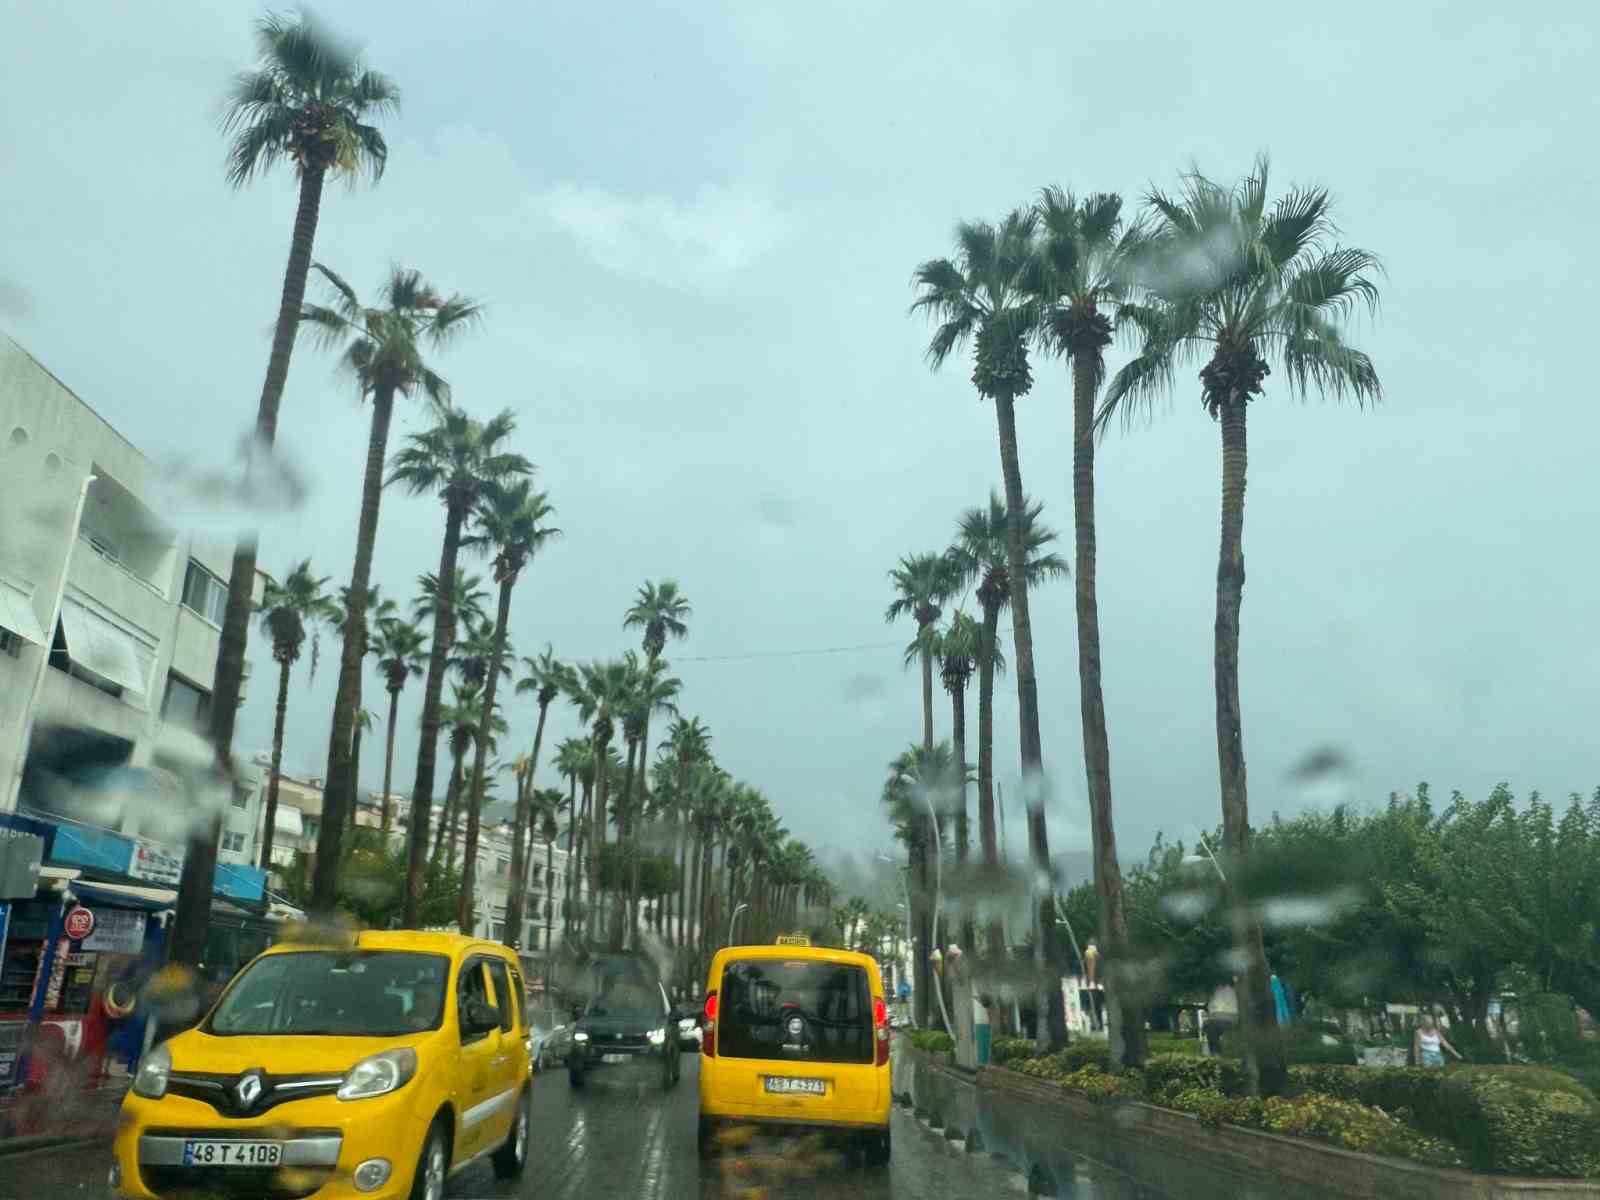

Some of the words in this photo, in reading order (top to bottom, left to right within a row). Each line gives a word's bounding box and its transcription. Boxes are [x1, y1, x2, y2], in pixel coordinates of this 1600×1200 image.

[194, 1145, 214, 1162] 48
[221, 1145, 231, 1162] T
[235, 1145, 278, 1162] 4108
